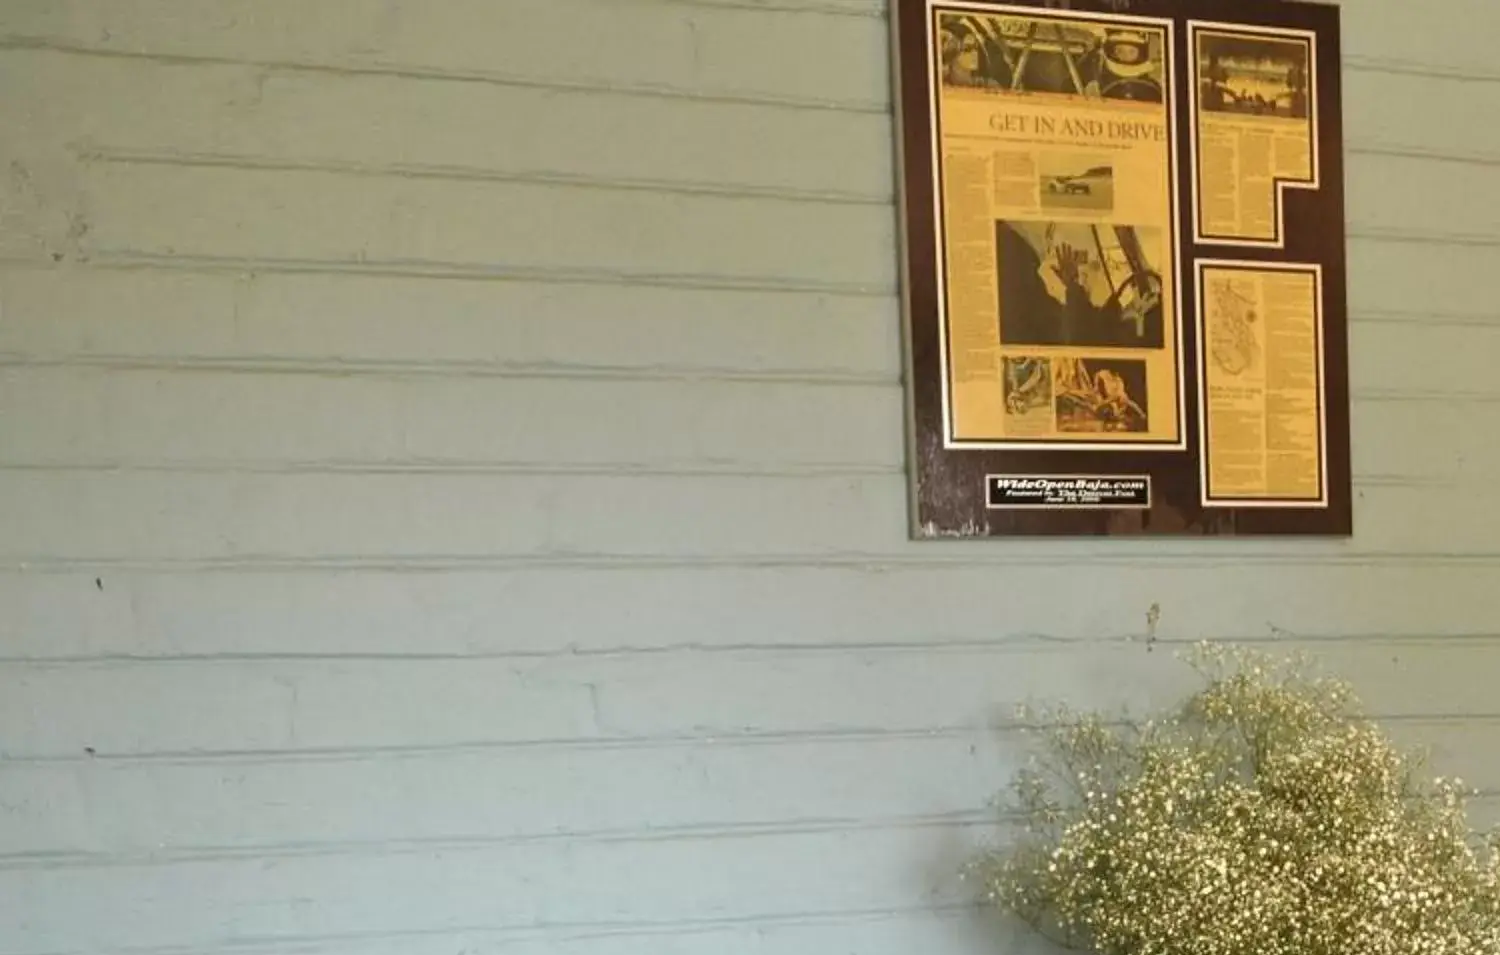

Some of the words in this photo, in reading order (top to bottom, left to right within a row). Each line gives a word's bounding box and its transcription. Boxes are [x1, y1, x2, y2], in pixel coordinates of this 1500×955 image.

[989, 113, 1030, 132] GET
[1034, 116, 1056, 134] IN
[1060, 118, 1103, 138] AND
[1107, 121, 1165, 142] DRIVE
